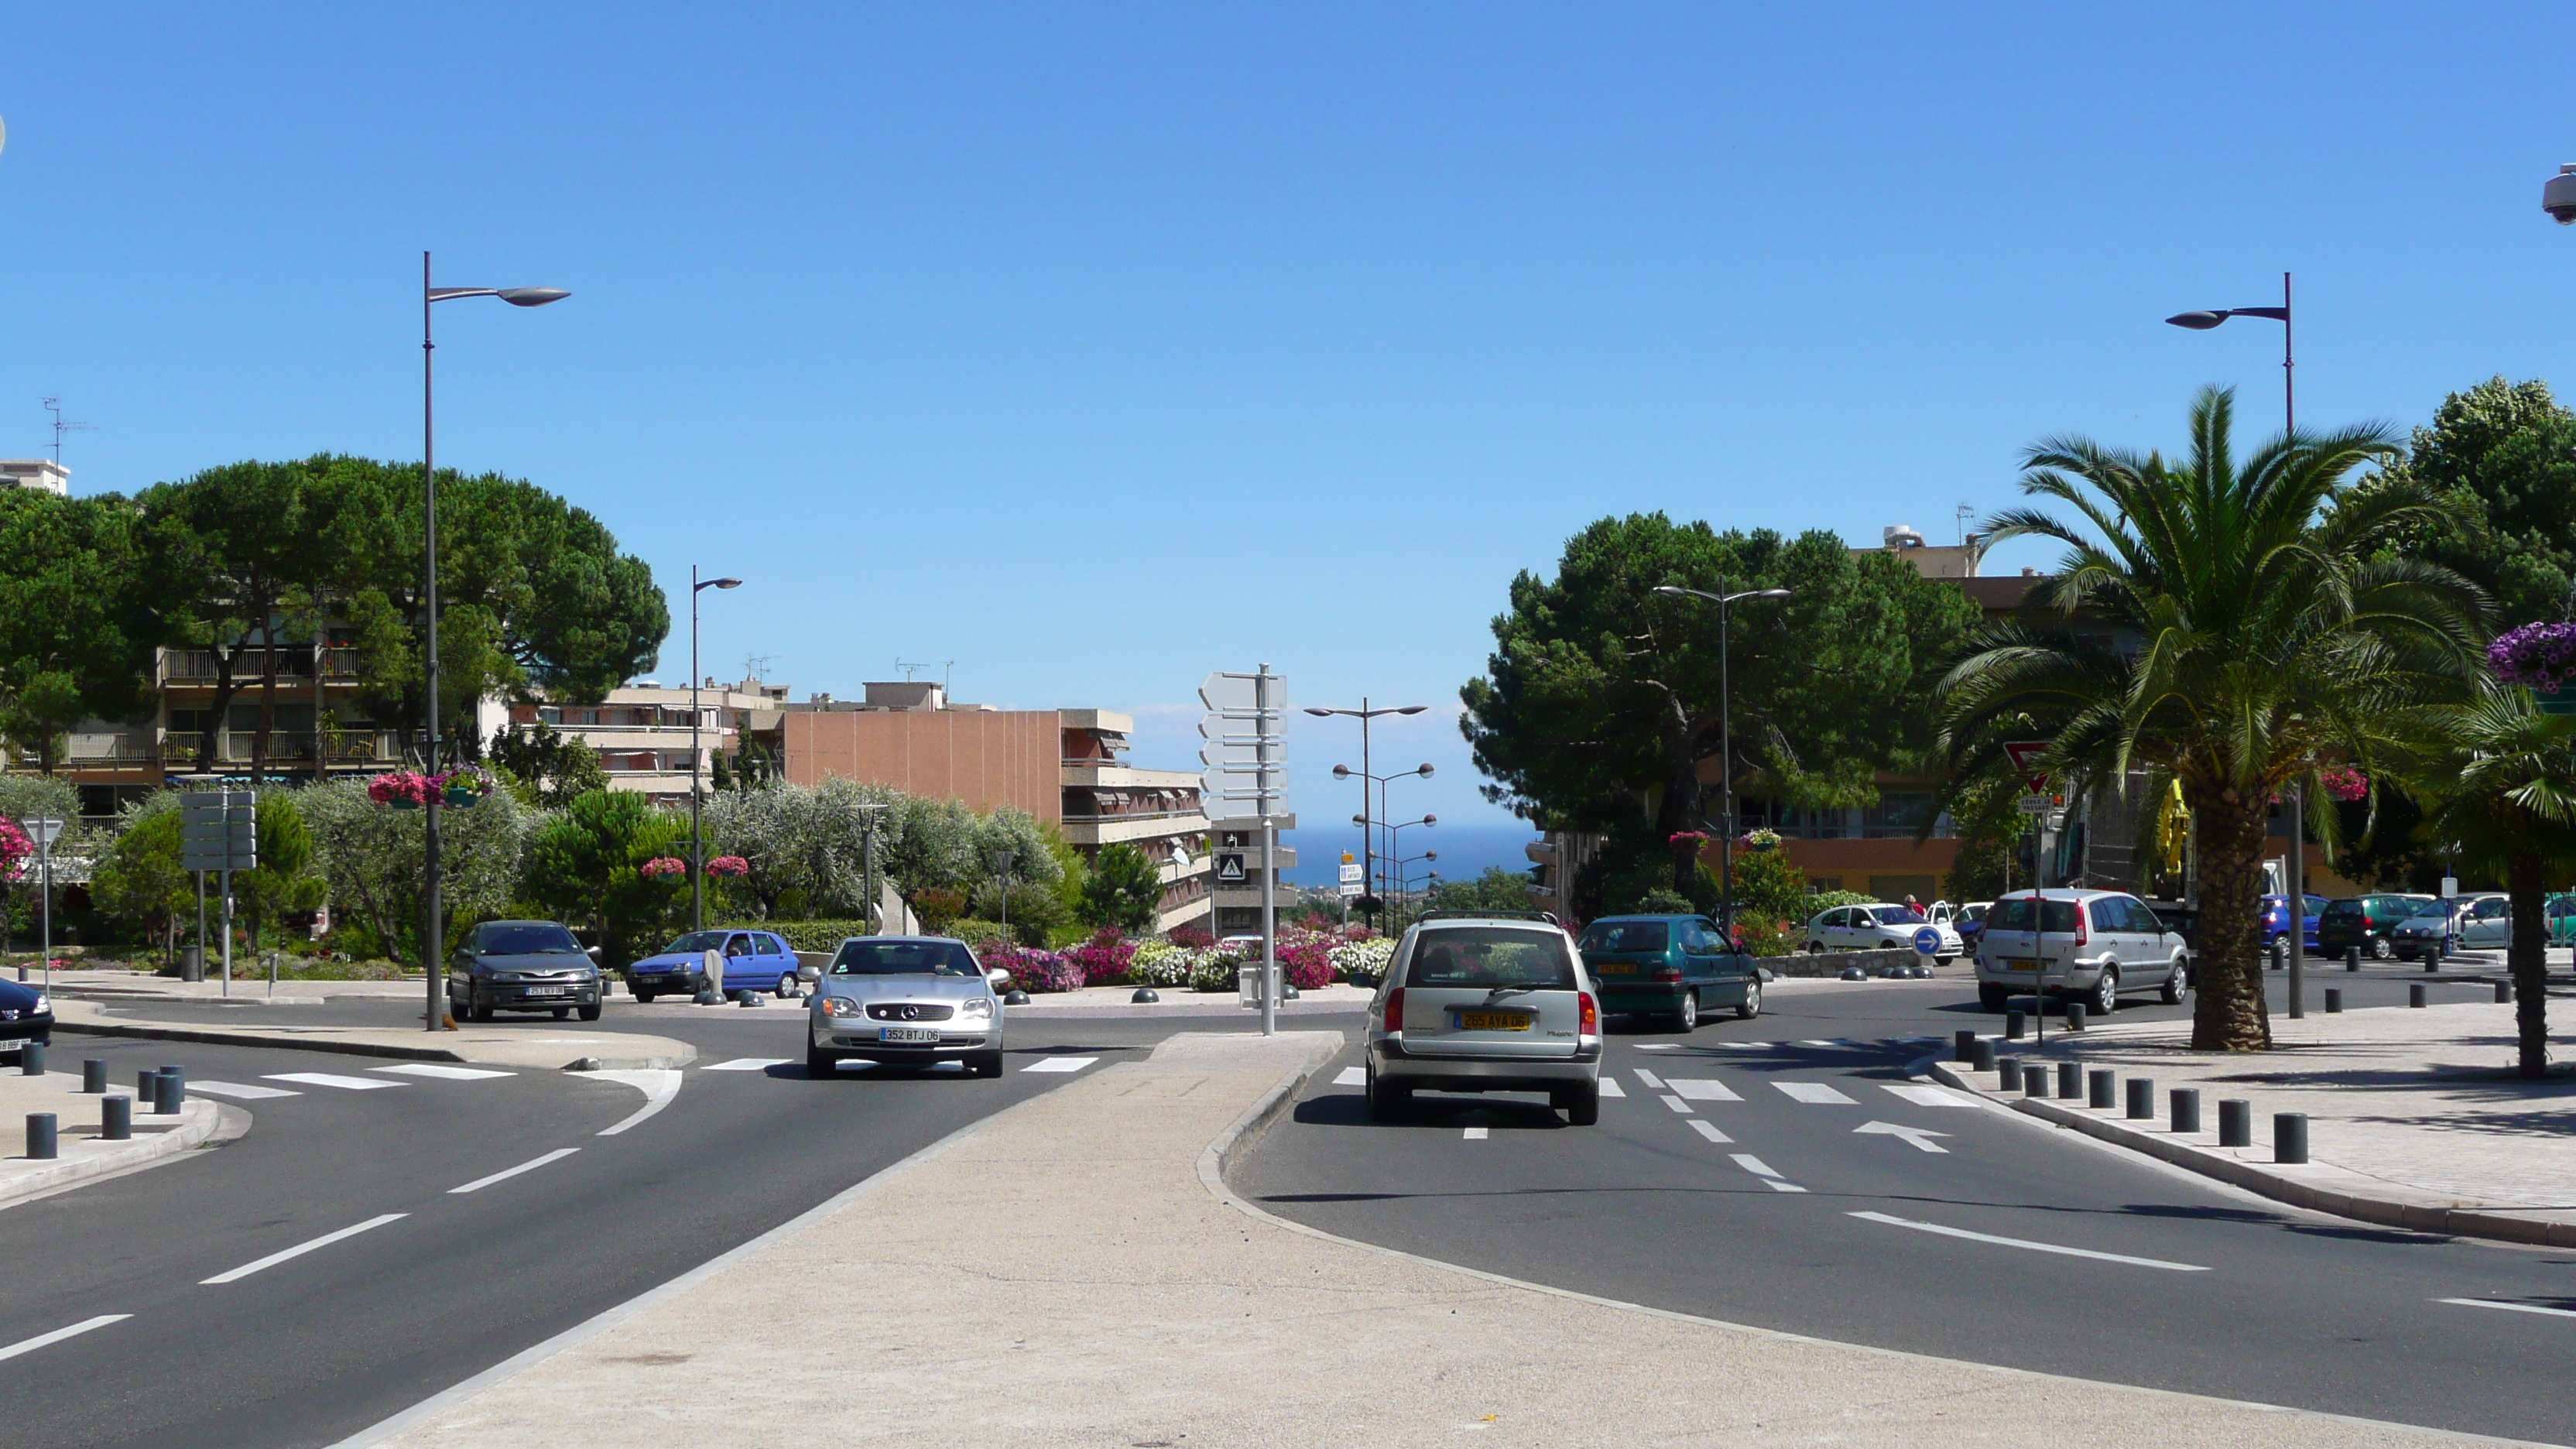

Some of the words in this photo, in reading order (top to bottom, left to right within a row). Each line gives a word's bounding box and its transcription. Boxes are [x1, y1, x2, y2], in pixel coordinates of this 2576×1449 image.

[1464, 1014, 1485, 1026] 265
[1488, 1015, 1509, 1027] AYA
[1511, 1016, 1526, 1027] 06
[886, 1029, 905, 1040] 352
[906, 1030, 925, 1040] BTJ
[927, 1030, 939, 1040] 06
